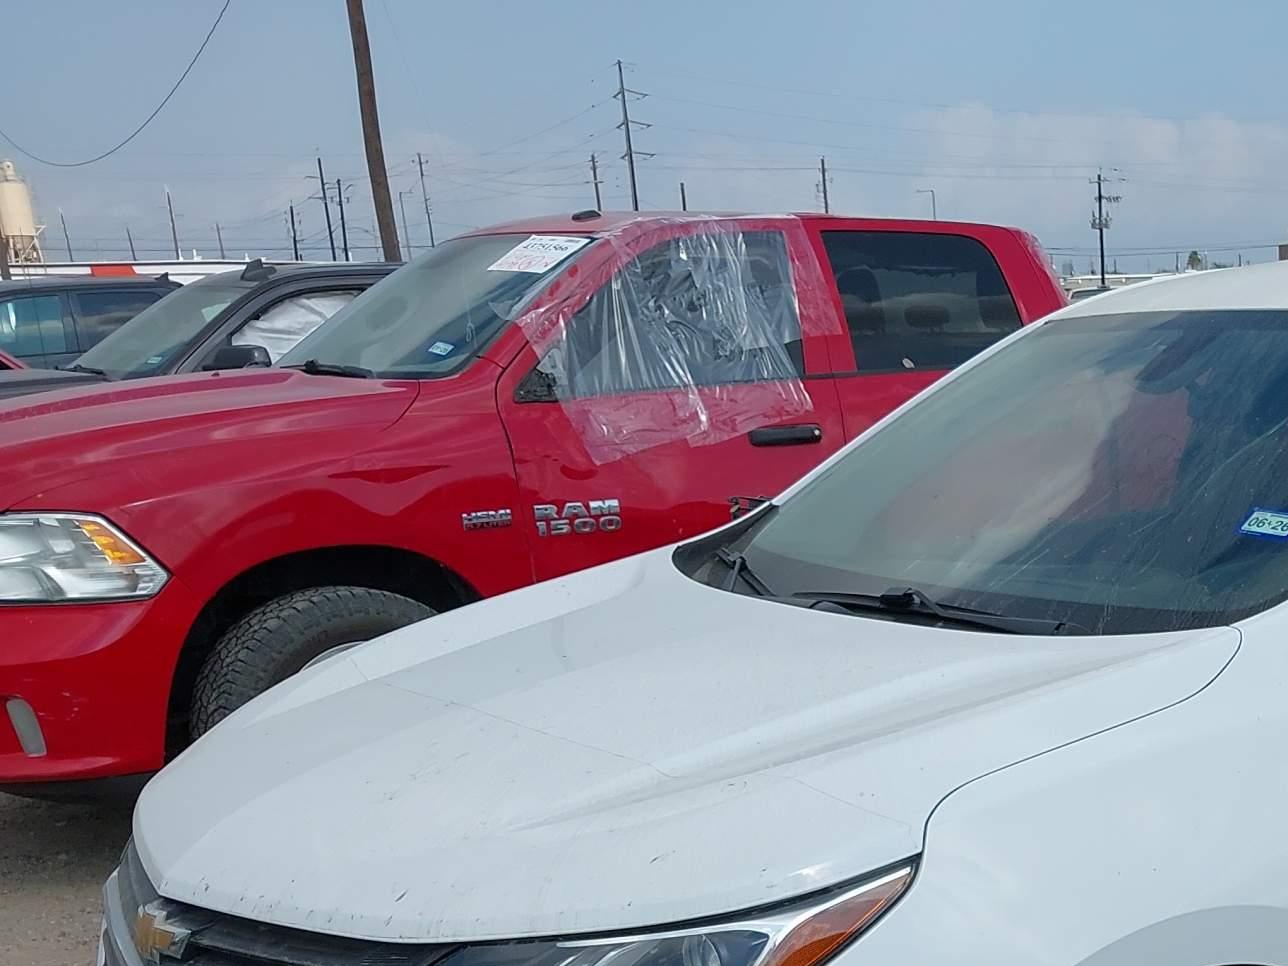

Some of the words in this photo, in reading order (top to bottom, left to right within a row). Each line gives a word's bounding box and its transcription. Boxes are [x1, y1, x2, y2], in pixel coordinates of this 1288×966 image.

[462, 508, 512, 523] HEMI
[533, 499, 620, 520] RAM
[536, 515, 622, 537] 1500
